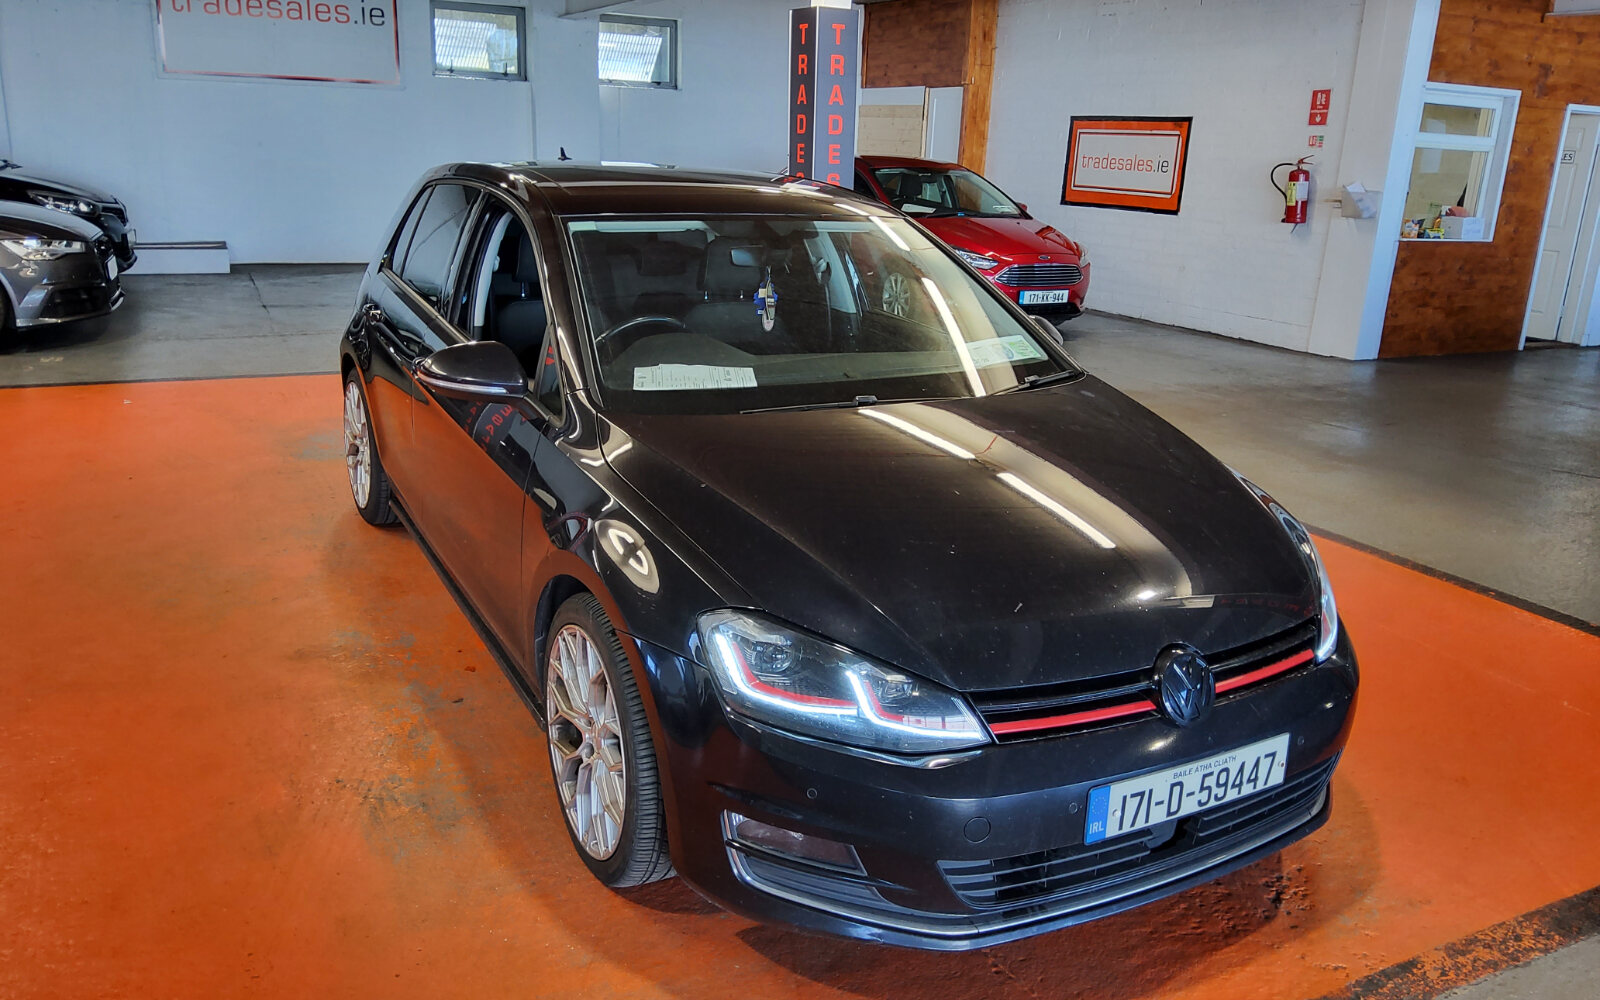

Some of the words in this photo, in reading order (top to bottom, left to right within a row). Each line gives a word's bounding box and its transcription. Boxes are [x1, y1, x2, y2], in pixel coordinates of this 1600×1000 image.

[796, 23, 808, 178] TRADE
[1081, 152, 1170, 174] tradesales.ie
[1029, 293, 1064, 303] 171-KK-944
[1173, 768, 1193, 779] BAILE
[1214, 755, 1237, 768] CLIATH
[1118, 751, 1277, 831] 171-D-59447
[1088, 820, 1105, 835] IRL
